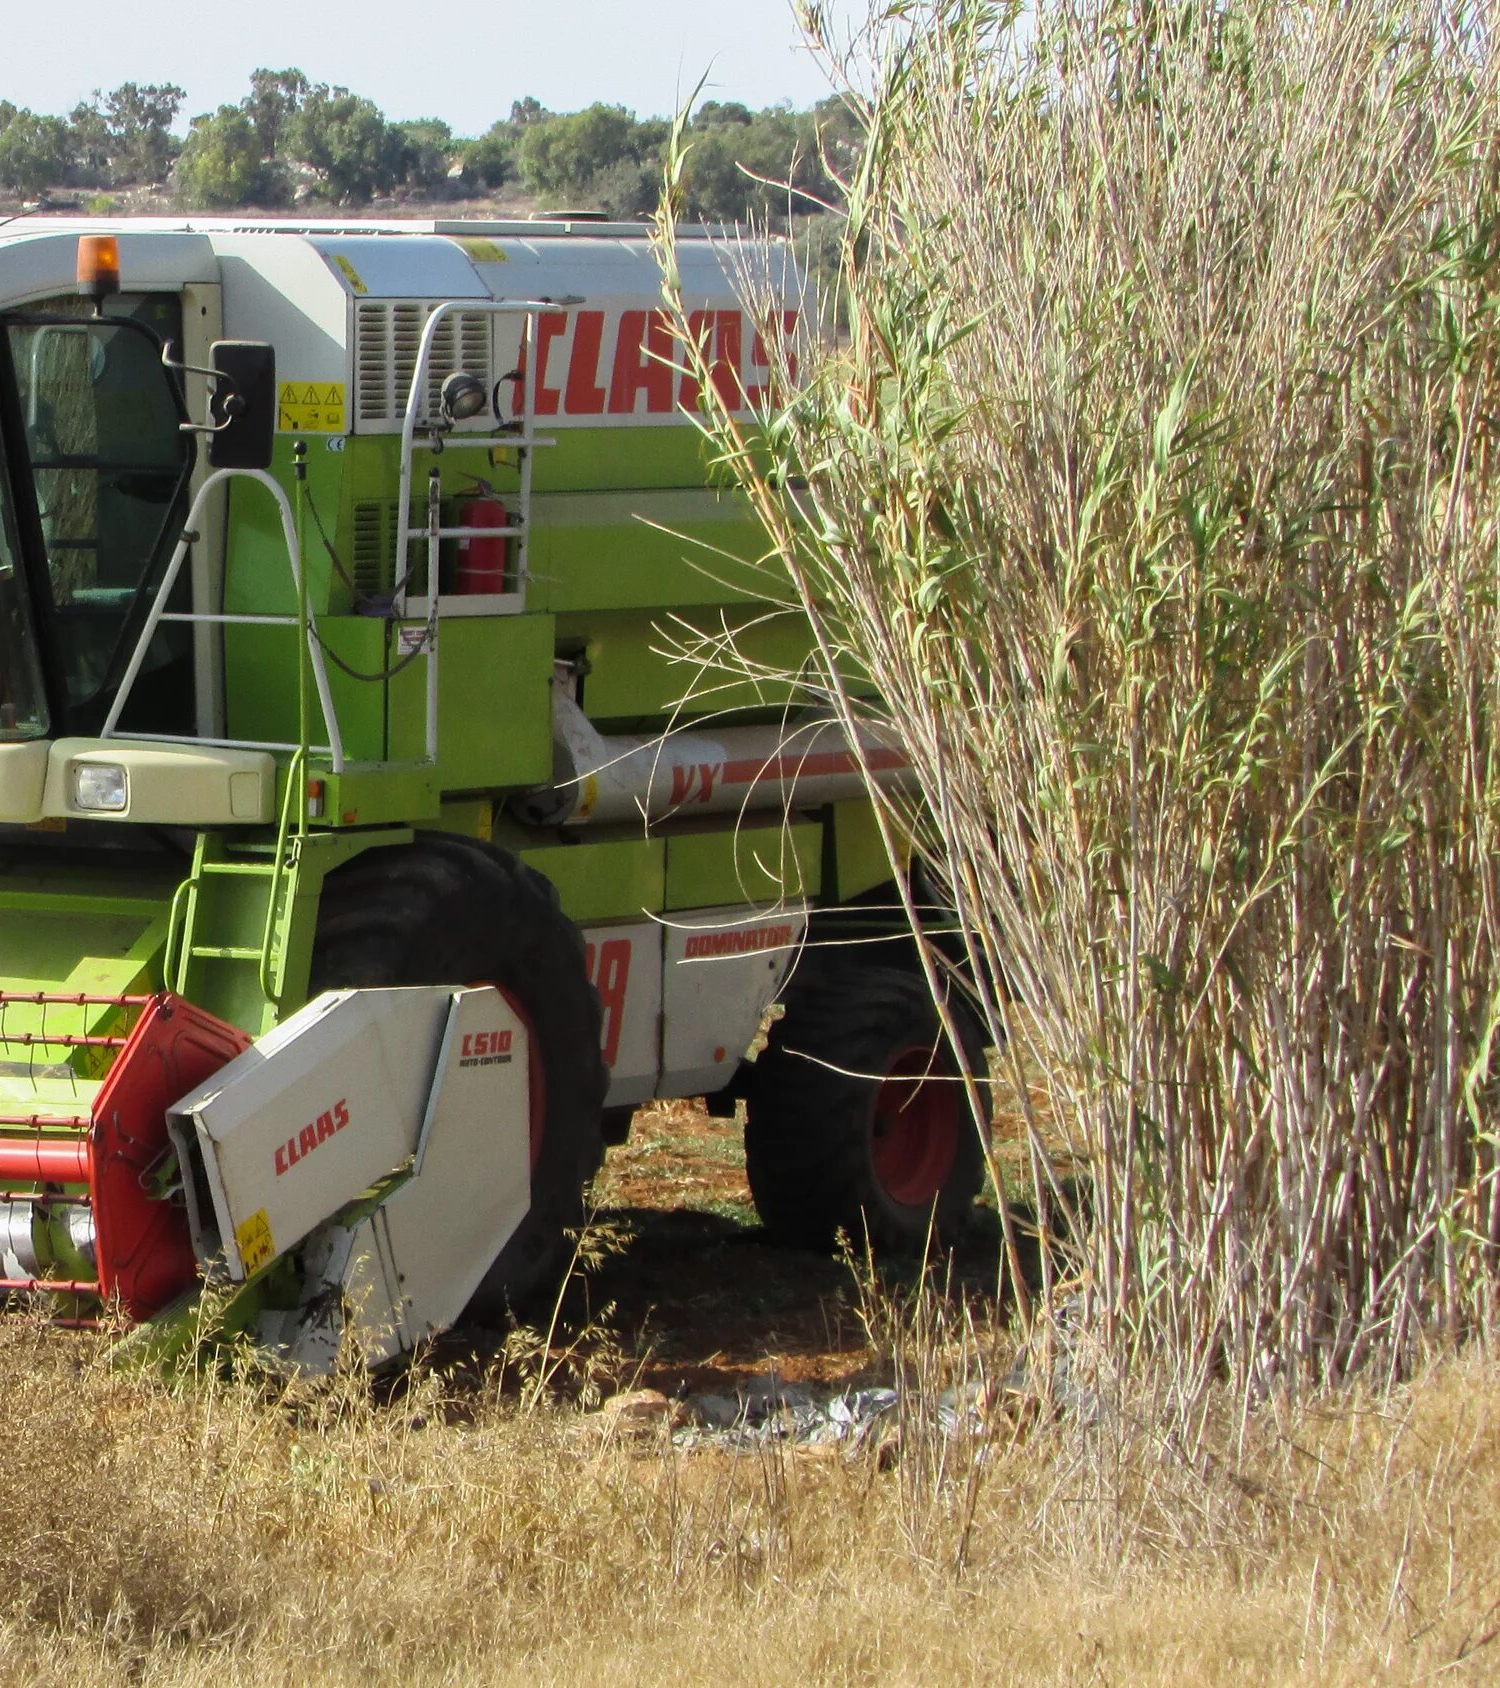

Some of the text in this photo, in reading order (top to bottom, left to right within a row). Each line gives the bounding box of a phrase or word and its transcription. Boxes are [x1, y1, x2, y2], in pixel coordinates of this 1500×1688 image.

[512, 309, 800, 416] CLAAS
[684, 925, 793, 959] DOMINATOR
[586, 938, 632, 1068] 9
[461, 1030, 513, 1057] C510
[275, 1098, 349, 1176] CLAAS
